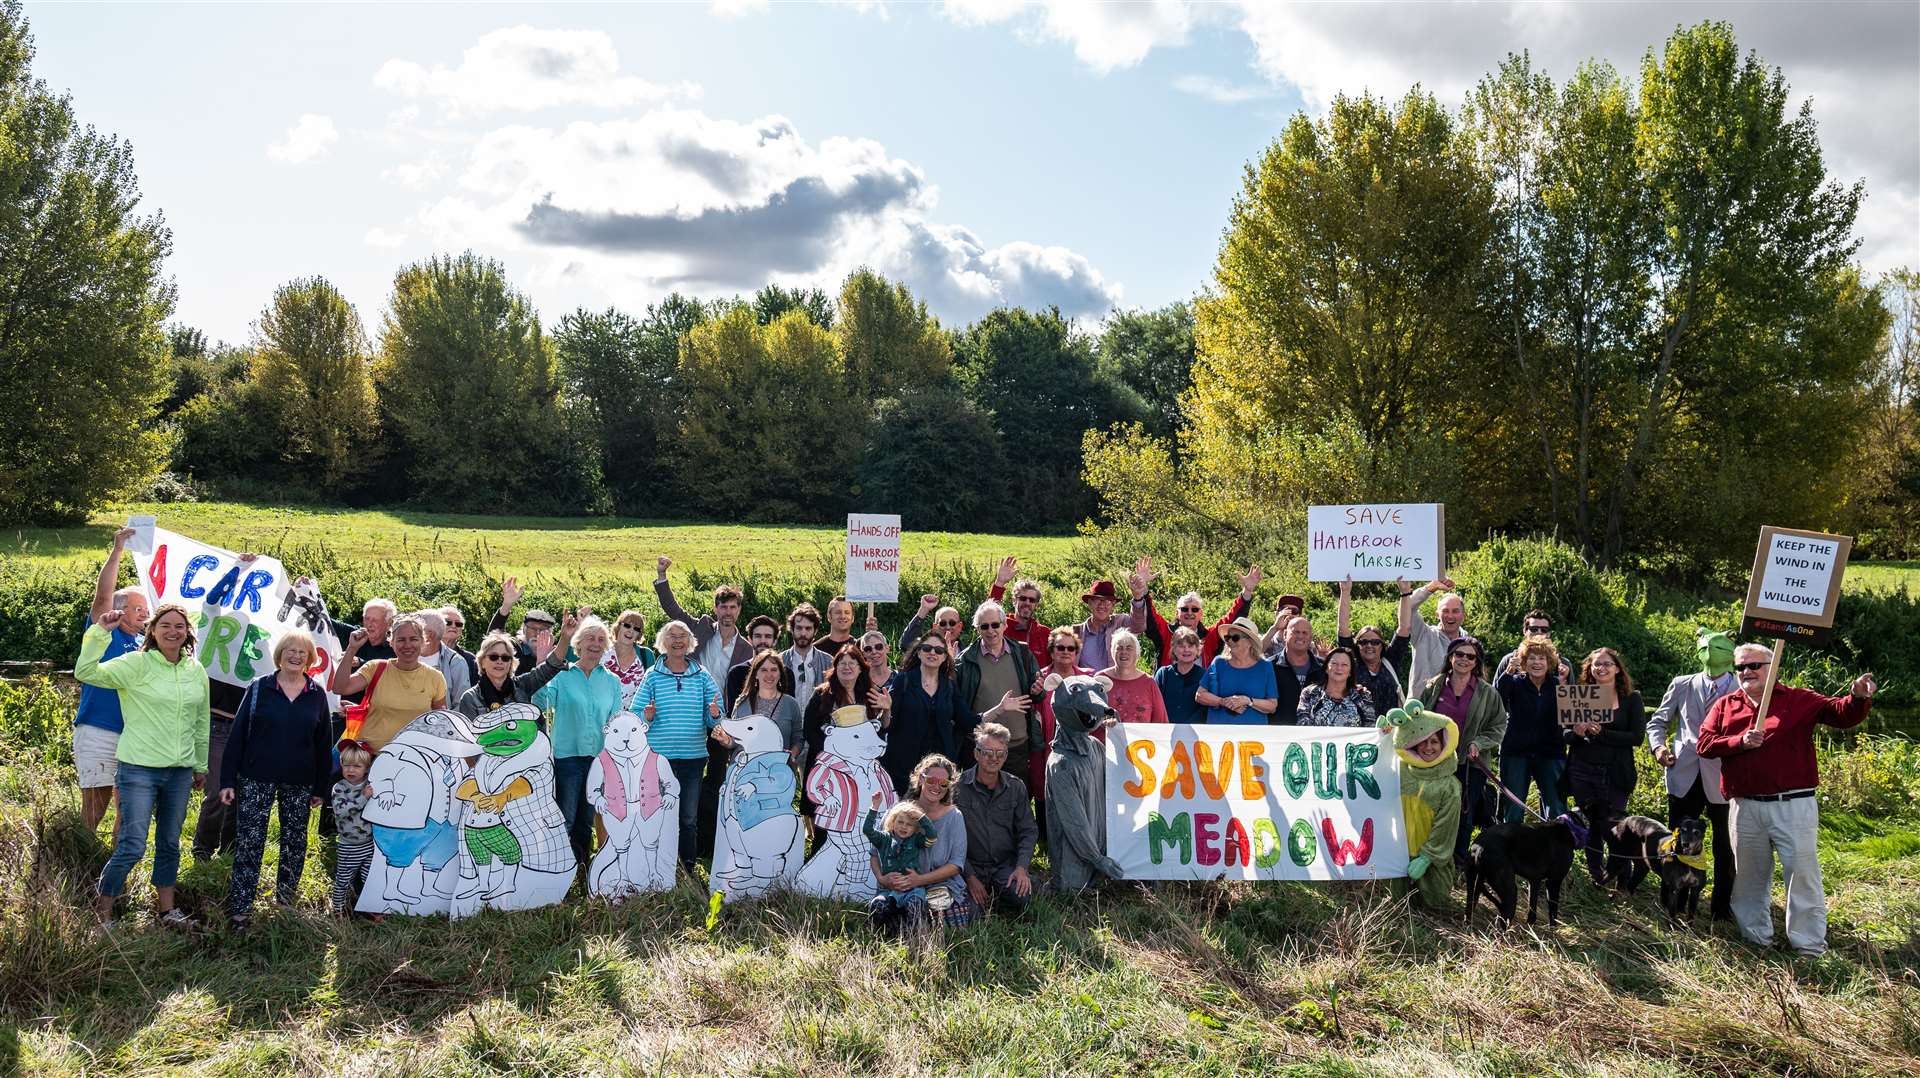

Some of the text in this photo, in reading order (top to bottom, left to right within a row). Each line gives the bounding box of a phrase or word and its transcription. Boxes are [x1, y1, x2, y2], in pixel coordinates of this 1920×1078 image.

[1344, 507, 1403, 525] SAVE
[850, 519, 900, 538] HANDS OFF
[1313, 530, 1403, 551] HAMBROOK
[1776, 539, 1832, 555] KEEP THE
[850, 544, 900, 558] HAMBROOK
[864, 560, 897, 572] MARSH
[1354, 551, 1423, 570] MARSHES
[1775, 556, 1826, 571] WIND IN
[180, 554, 274, 613] CAR
[1784, 577, 1807, 589] THE
[1764, 591, 1821, 607] WILLOWS
[1752, 620, 1815, 636] #StandAsOne
[1557, 685, 1600, 699] SAVE
[1571, 699, 1590, 708] the
[1560, 709, 1612, 723] MARSH
[1123, 739, 1382, 800] SAVE OUR
[1148, 811, 1375, 869] MEADOW
